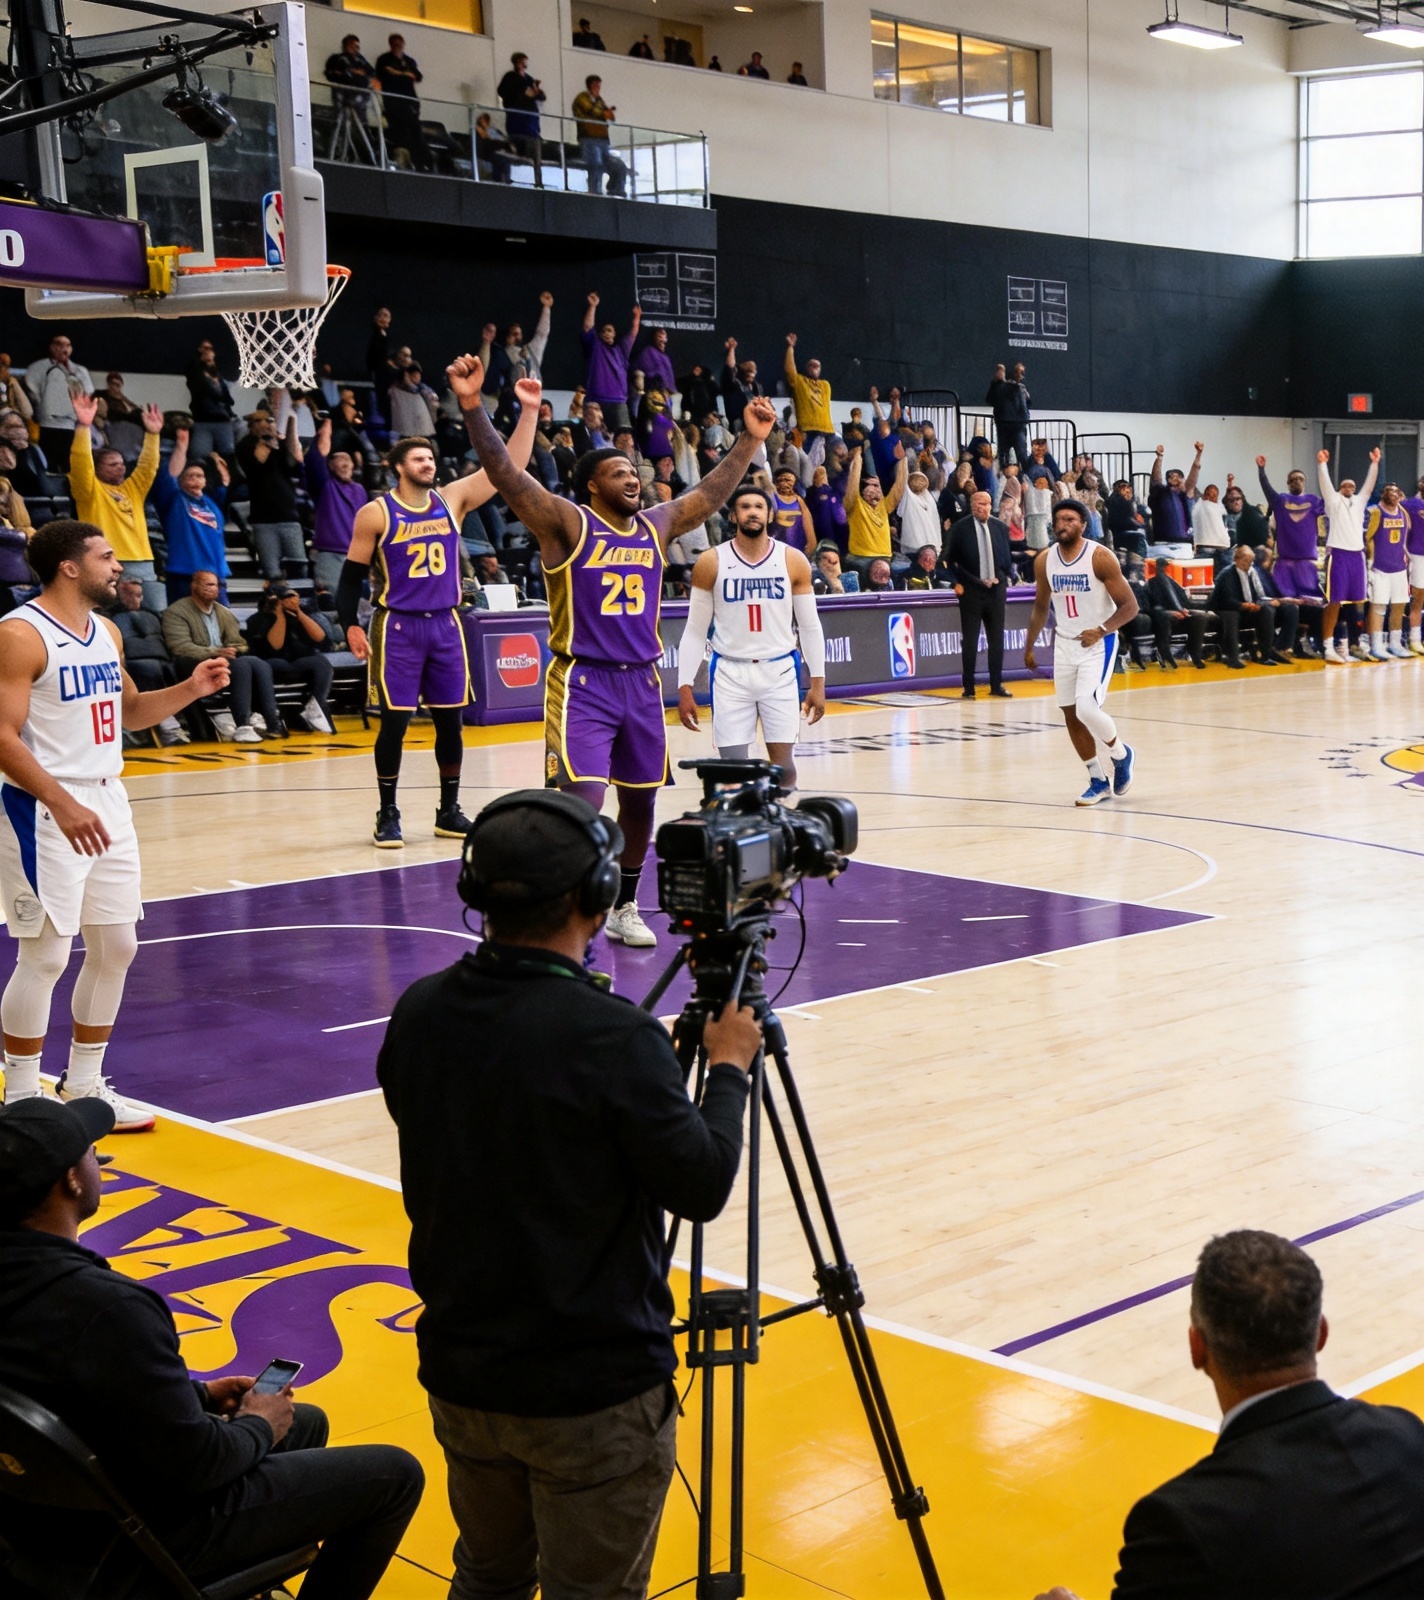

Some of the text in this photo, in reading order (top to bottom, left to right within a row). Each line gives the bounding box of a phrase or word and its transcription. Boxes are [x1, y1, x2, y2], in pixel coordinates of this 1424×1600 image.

[407, 542, 446, 578] 28
[600, 572, 645, 616] 29
[747, 604, 762, 632] 11
